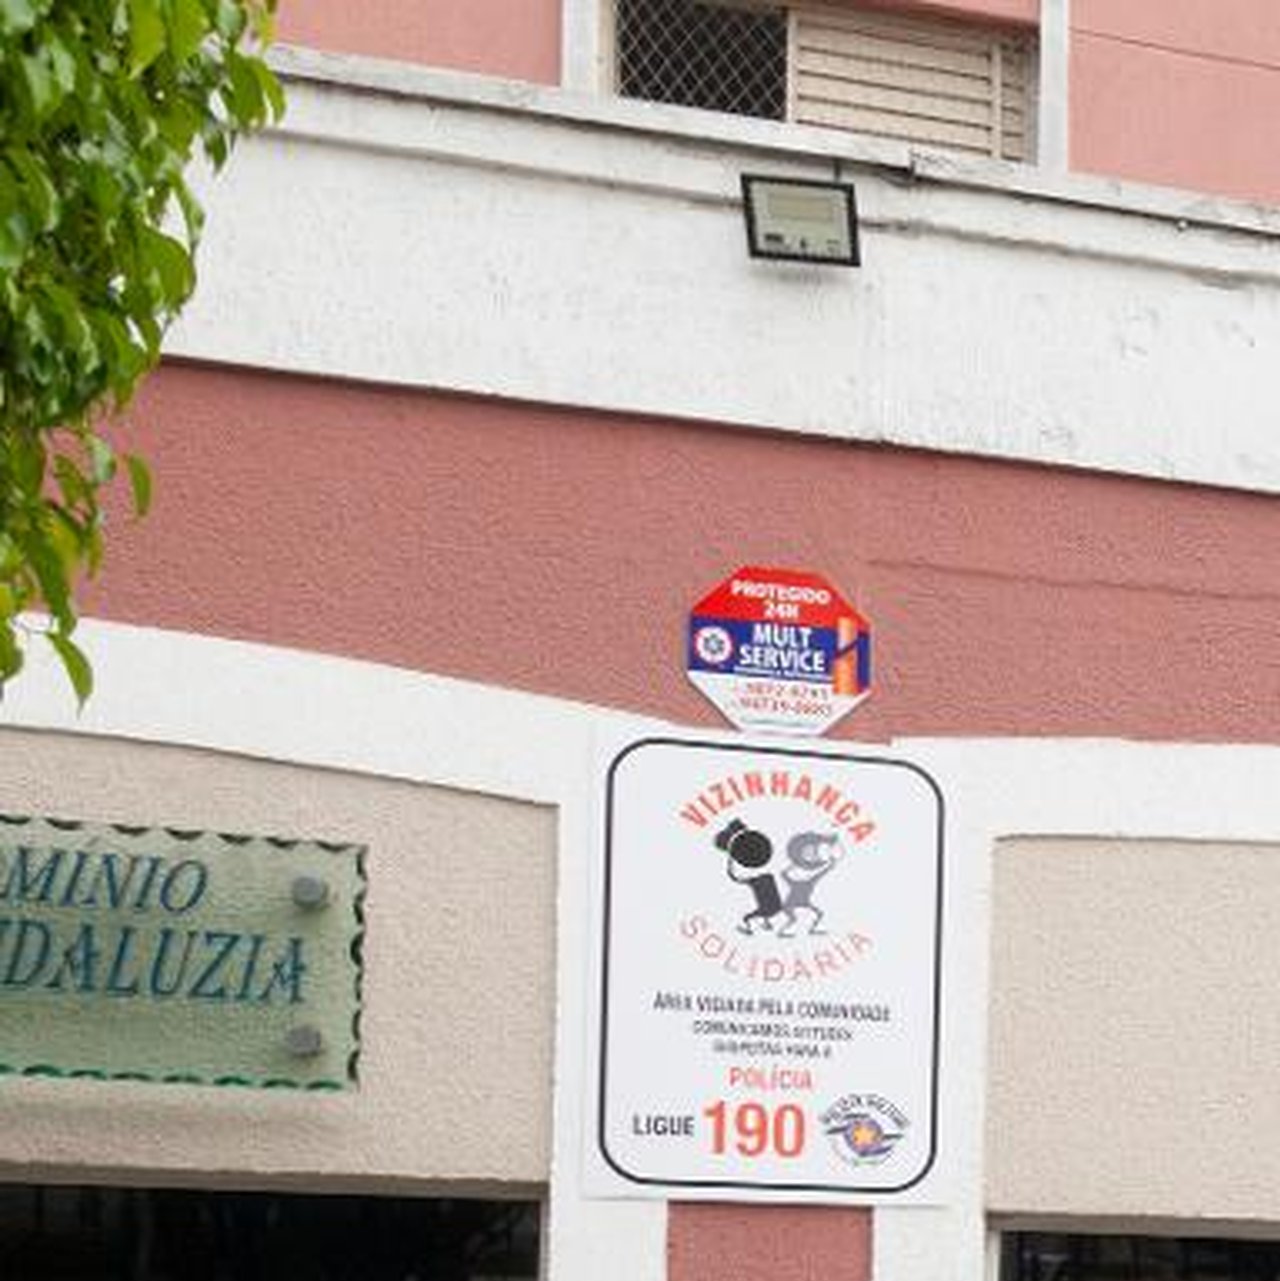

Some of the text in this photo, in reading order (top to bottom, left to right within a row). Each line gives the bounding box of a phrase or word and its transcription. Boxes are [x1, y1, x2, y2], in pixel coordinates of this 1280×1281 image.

[730, 580, 831, 604] PROTEGIDO
[763, 602, 800, 618] 24H
[753, 623, 812, 648] MULT
[739, 644, 826, 672] SERVICE
[0, 918, 309, 1004] DALUZIA
[758, 997, 794, 1016] PELA
[797, 1001, 890, 1022] COMUNIDADE
[632, 1100, 806, 1159] LIGUE 190
